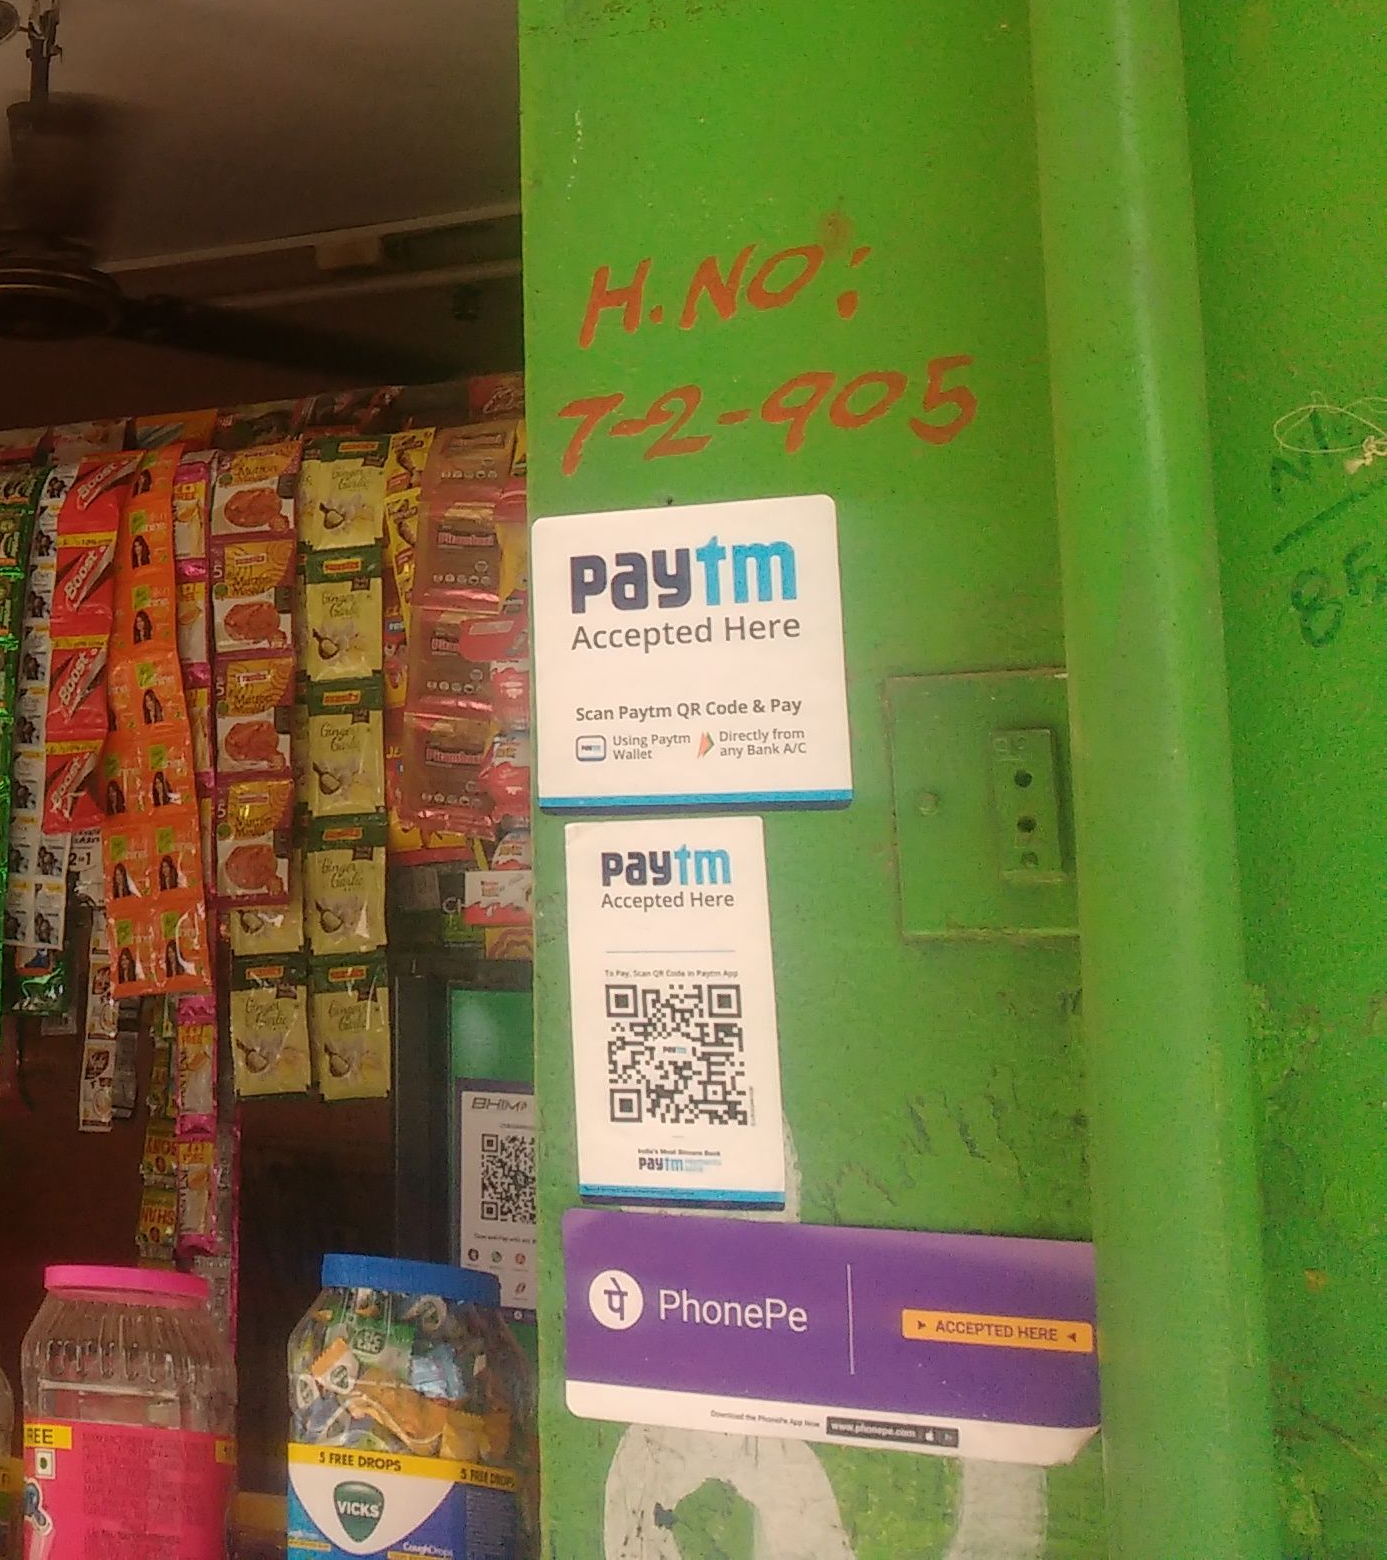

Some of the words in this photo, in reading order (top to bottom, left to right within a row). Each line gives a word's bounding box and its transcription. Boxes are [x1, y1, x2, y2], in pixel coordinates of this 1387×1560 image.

[557, 353, 979, 477] 7-2-905
[570, 535, 797, 614] paytm
[571, 617, 712, 654] Accepted
[724, 616, 801, 641] Here
[576, 706, 614, 721] Scan
[618, 705, 672, 723] Paytm
[677, 703, 701, 718] QR
[706, 700, 748, 716] Code
[753, 700, 765, 713] &
[770, 698, 802, 714] Pay
[613, 734, 648, 747] Using
[651, 733, 691, 746] Paytm
[719, 730, 769, 744] Directly
[772, 728, 805, 740] from
[613, 748, 652, 760] Wallet
[720, 745, 743, 758] any
[747, 744, 779, 755] Bank
[783, 742, 807, 754] A/C
[601, 844, 731, 886] paytm
[601, 891, 684, 912] Accepted
[691, 892, 734, 907] Here
[696, 970, 721, 978] Paytm
[639, 1157, 683, 1171] paytm
[659, 1288, 809, 1333] PhonePe
[935, 1318, 1015, 1339] ACCEPTED
[1017, 1324, 1059, 1342] HERE
[830, 1421, 916, 1438] www.phonepe.com
[319, 1452, 326, 1463] 5
[329, 1455, 354, 1466] FREE
[358, 1458, 401, 1472] DROPS
[460, 1468, 467, 1480] 5
[470, 1470, 488, 1483] FREE
[337, 1500, 380, 1518] VICKS
